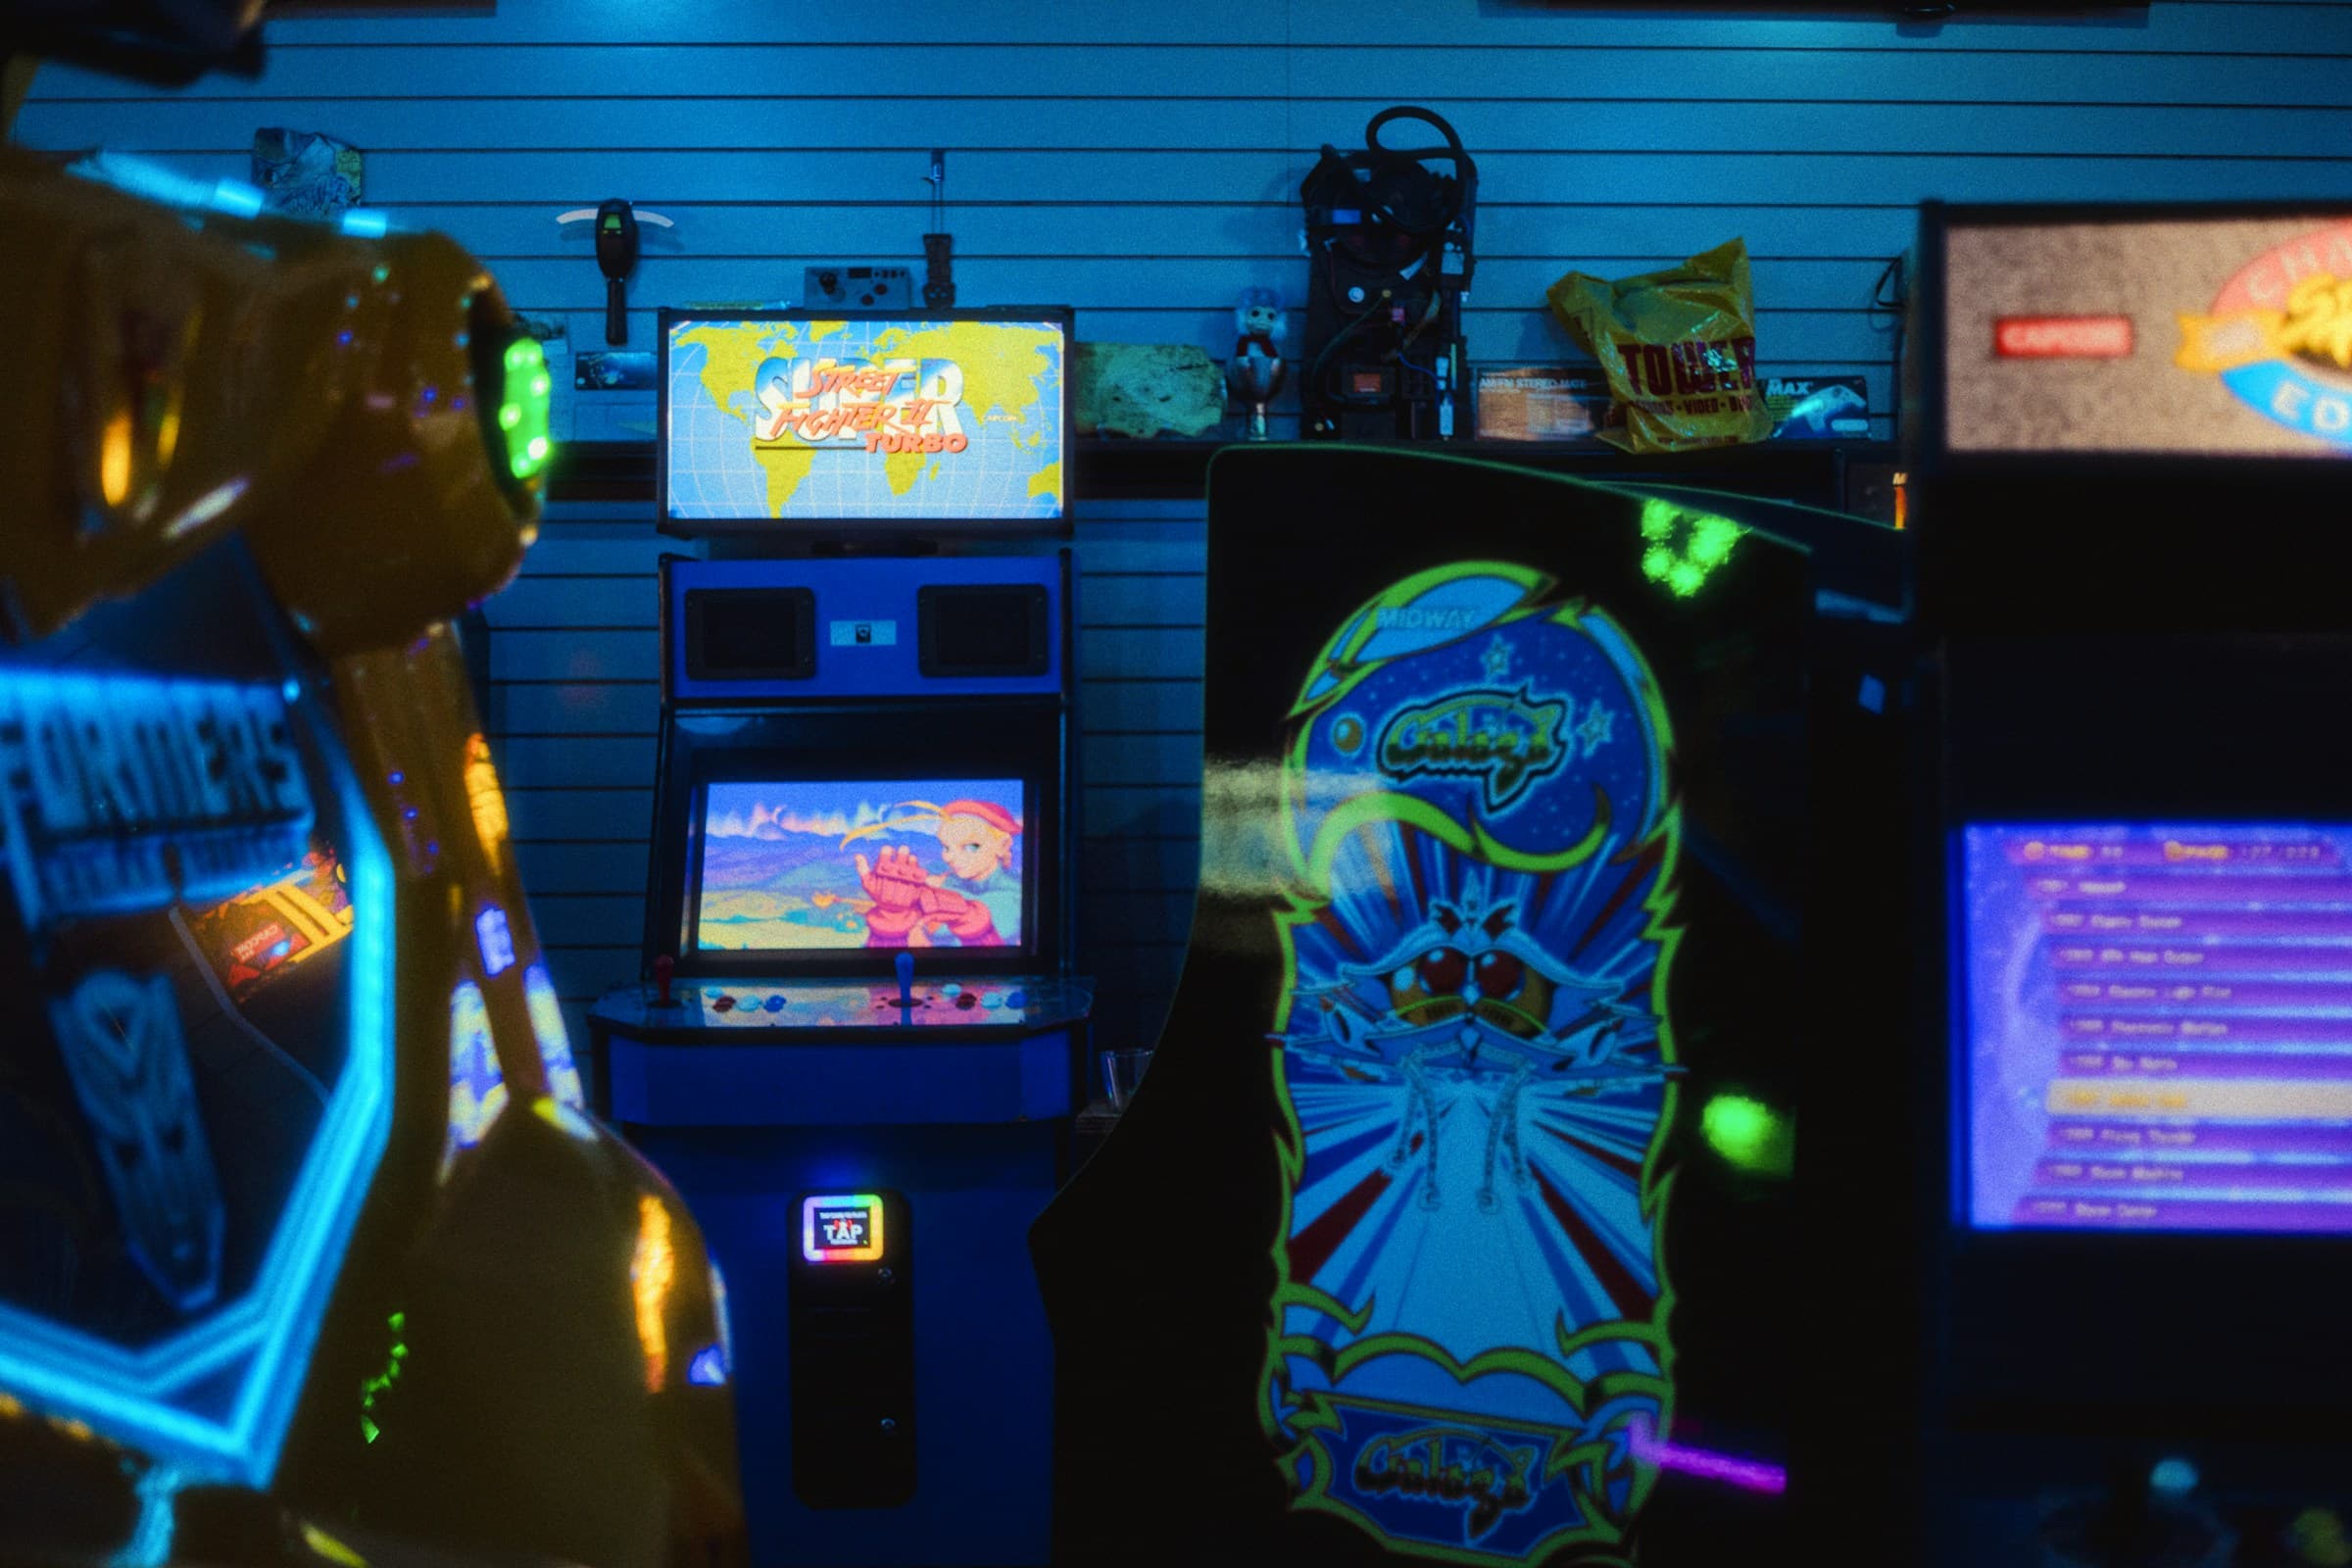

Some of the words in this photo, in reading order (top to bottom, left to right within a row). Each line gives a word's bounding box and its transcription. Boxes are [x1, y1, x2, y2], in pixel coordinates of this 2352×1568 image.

[795, 358, 917, 398] STREET
[755, 357, 963, 441] SUPER
[769, 402, 912, 437] FIGHTER
[865, 433, 968, 454] TURBO
[1377, 608, 1476, 629] MIDWAY
[823, 1219, 863, 1240] TAP
